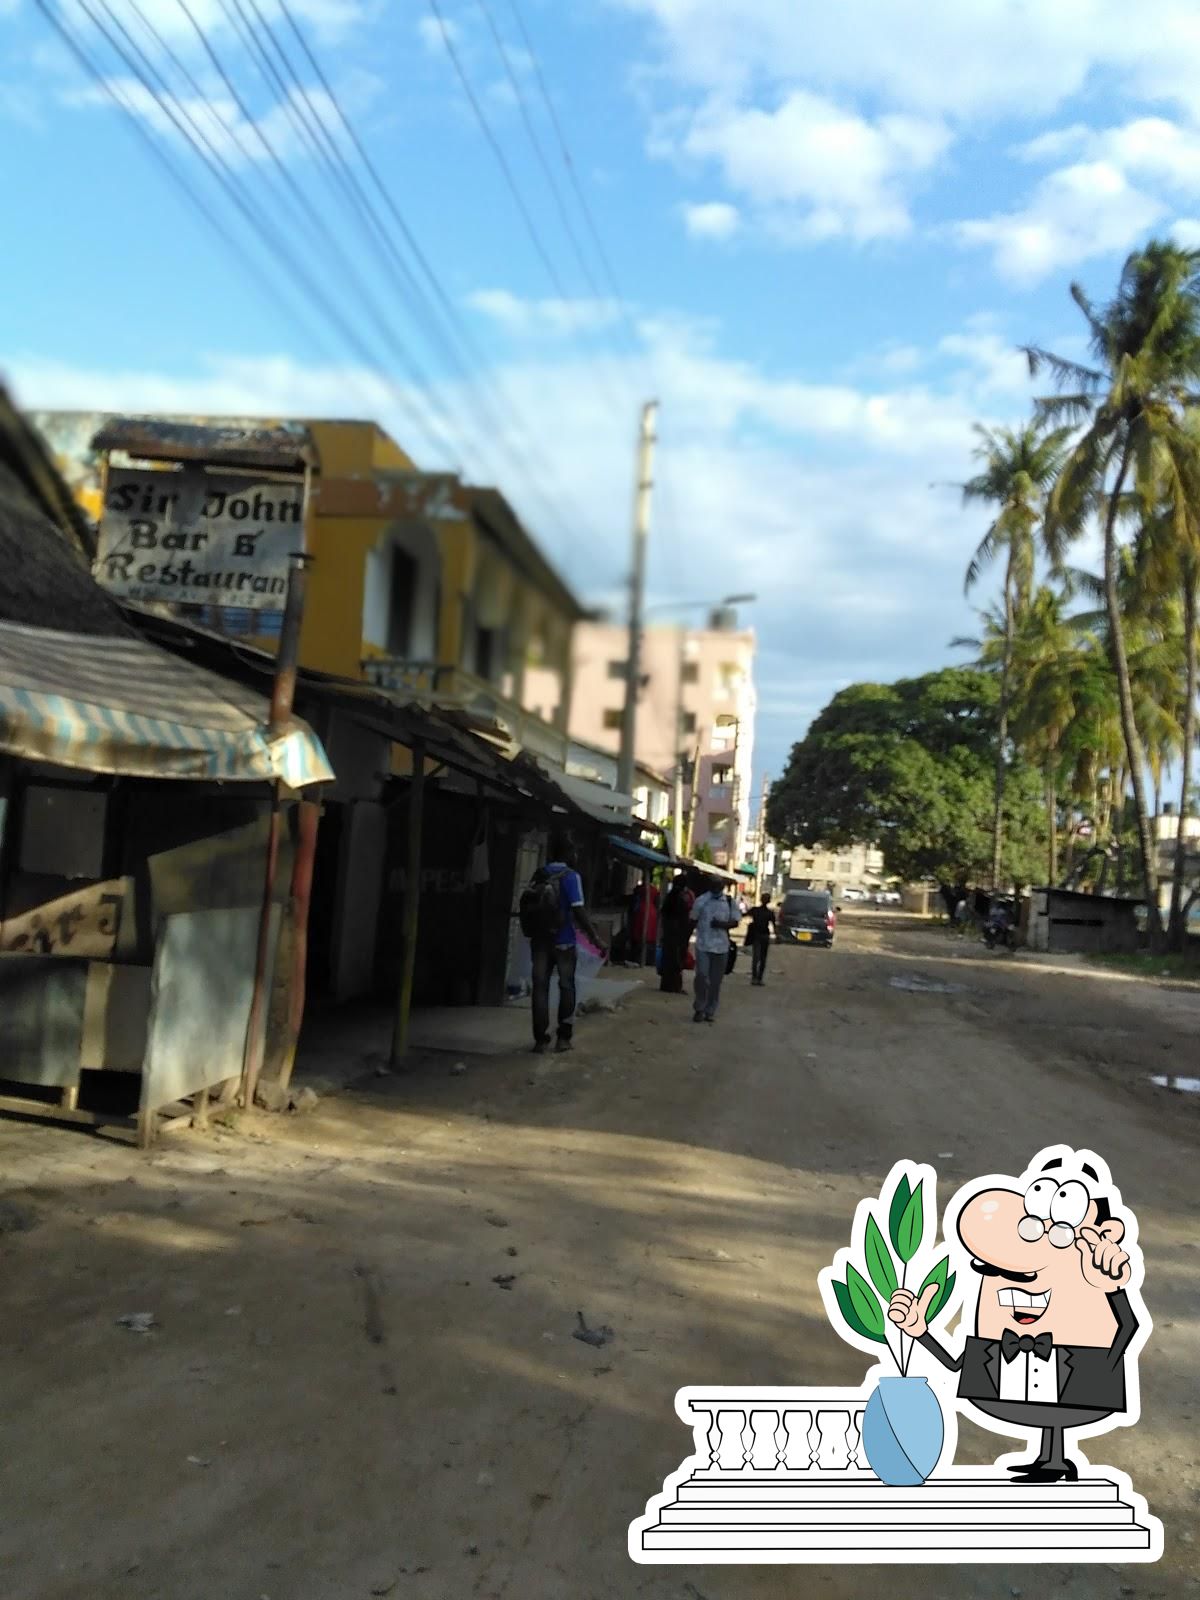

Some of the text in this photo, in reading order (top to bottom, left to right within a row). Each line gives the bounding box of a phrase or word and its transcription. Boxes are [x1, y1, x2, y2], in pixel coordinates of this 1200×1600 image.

[108, 483, 300, 523] Sir John
[129, 518, 208, 550] Bar
[103, 552, 285, 594] Restauran
